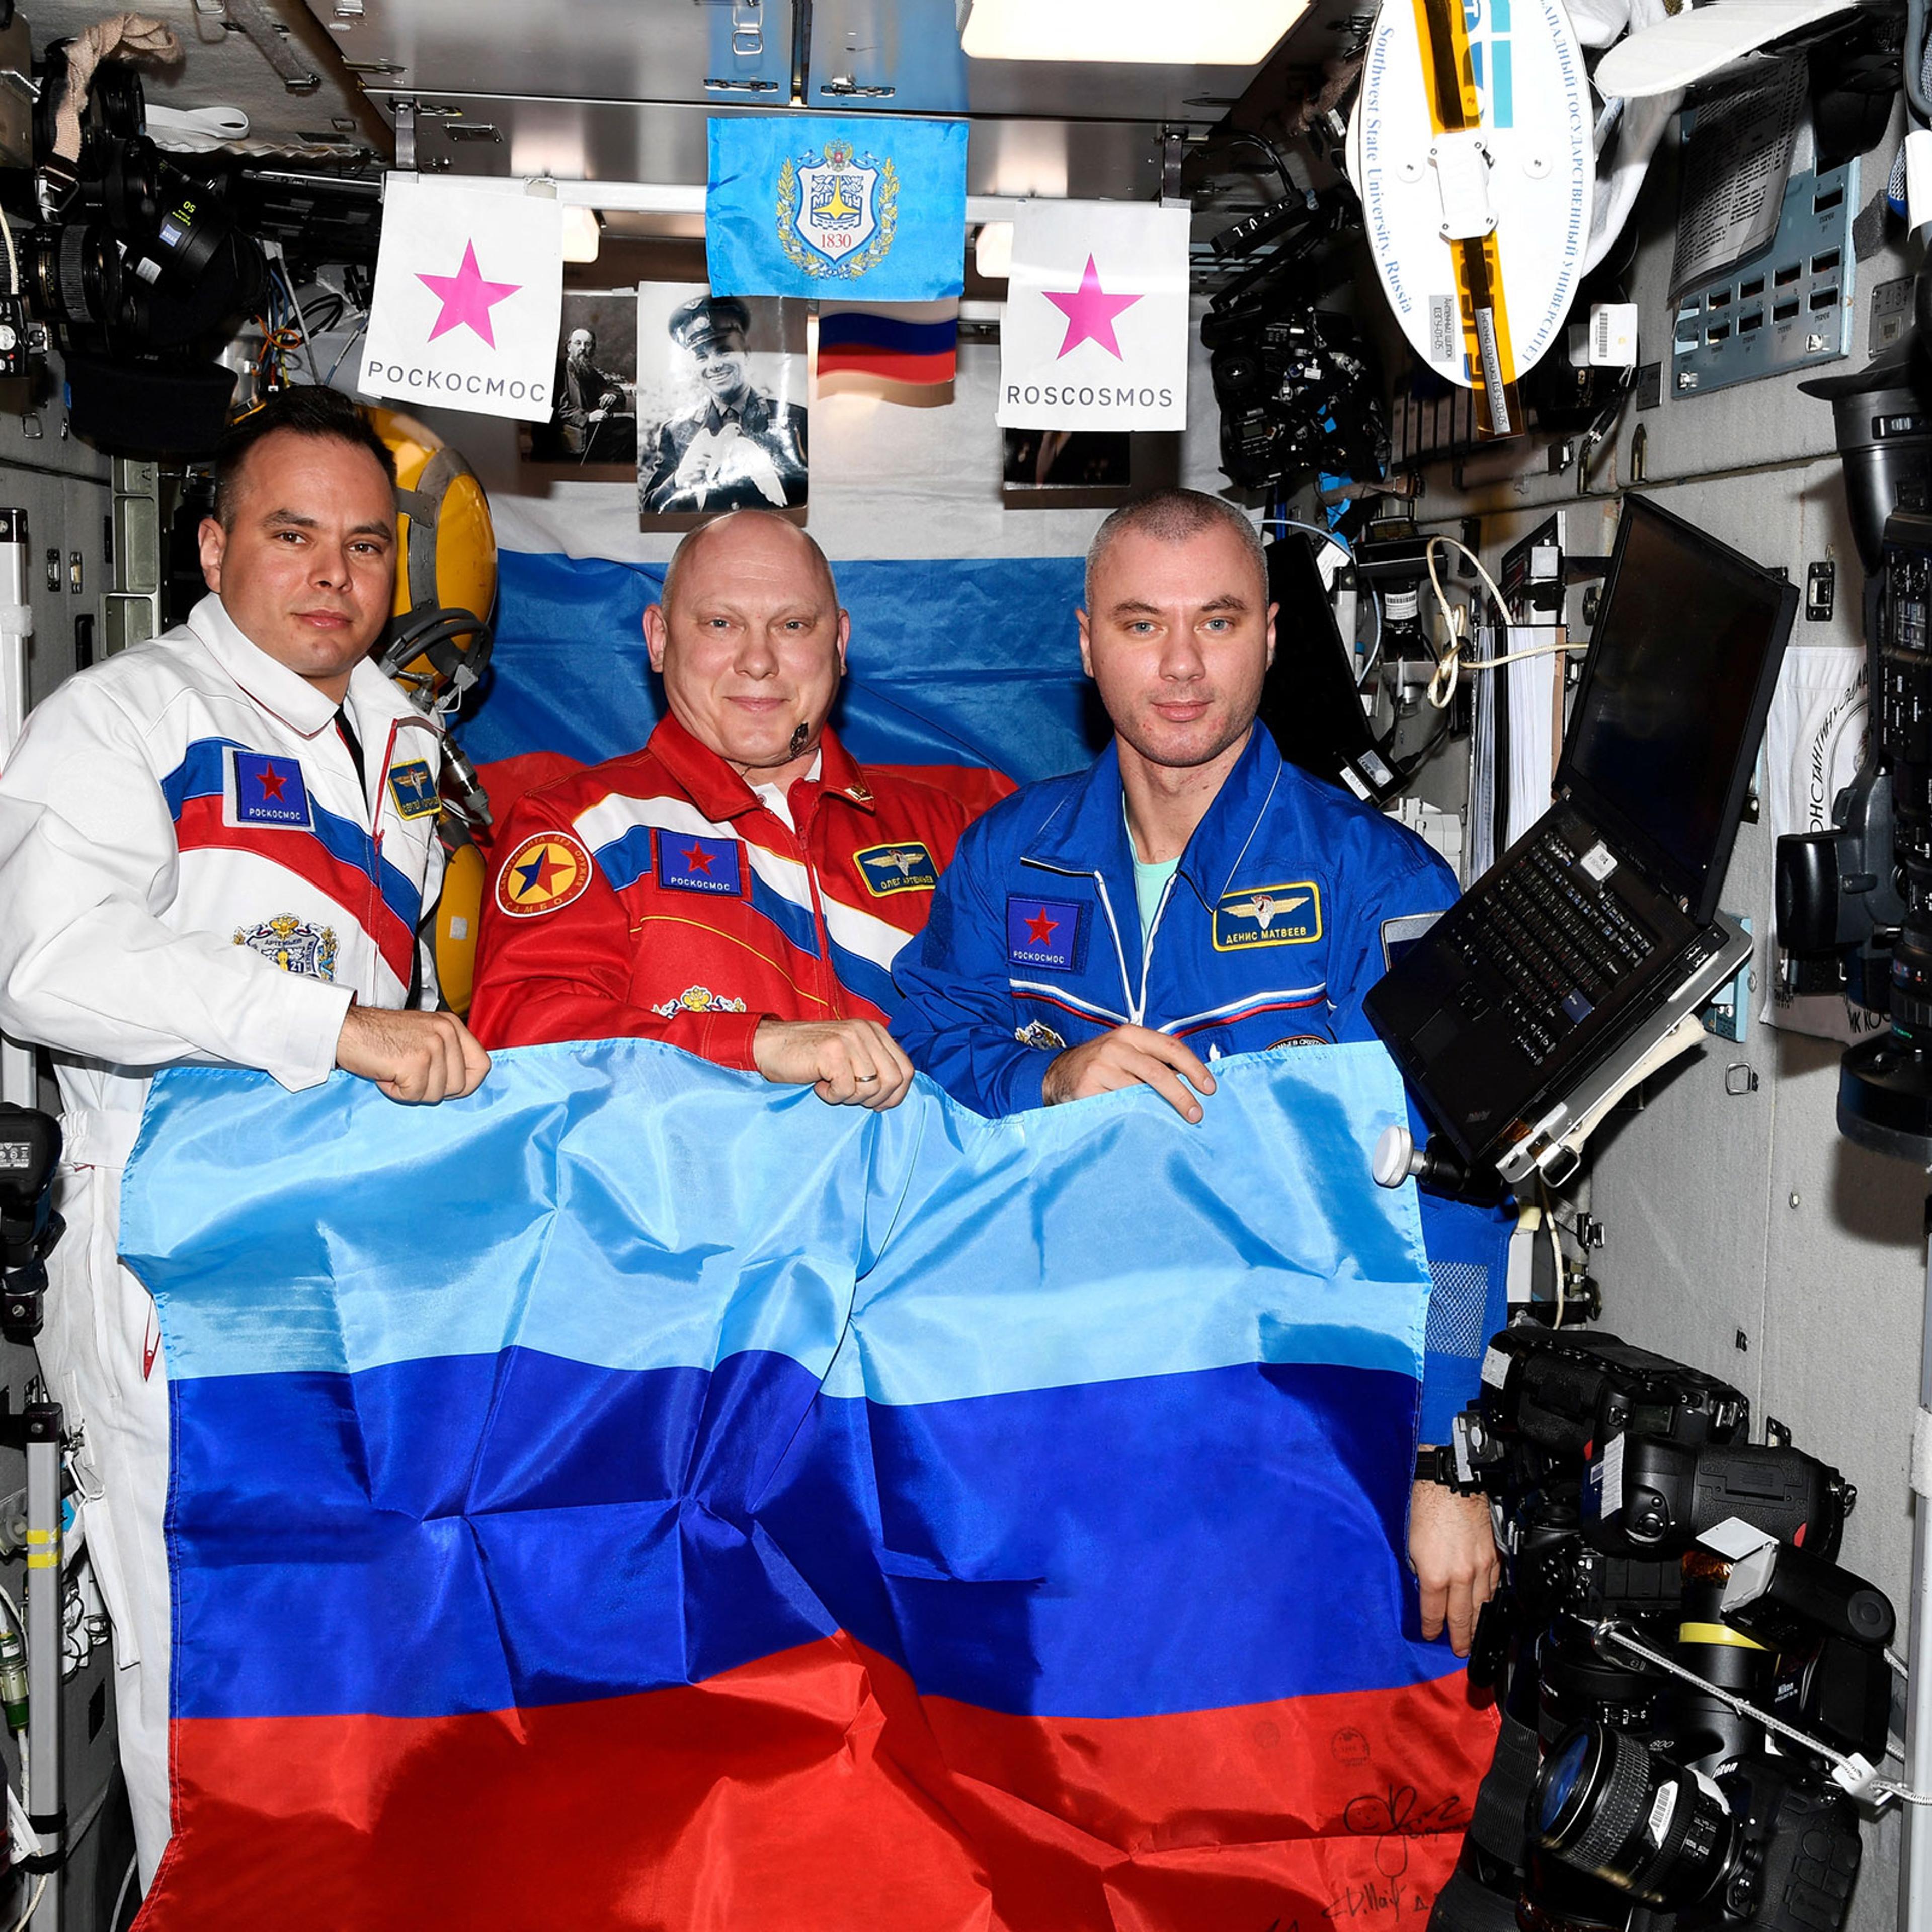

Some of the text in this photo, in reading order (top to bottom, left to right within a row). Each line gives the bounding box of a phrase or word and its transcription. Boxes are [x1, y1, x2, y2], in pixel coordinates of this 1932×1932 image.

[1367, 25, 1394, 112] Southwest
[1366, 119, 1382, 161] State
[1522, 0, 1583, 364] АПАДНЫЙ ГОСУДАРСТВЕННЫЙ УНИВЕРСИТЕТ
[822, 233, 852, 248] 1830
[1385, 260, 1412, 314] Russia
[367, 360, 546, 403] РОСКОСМОС
[1007, 385, 1172, 407] ROSCOSMOS
[249, 807, 301, 820] РОСКОСМОС
[554, 835, 572, 846] БЕЗ
[574, 850, 588, 888] ОРУЖИЯ
[670, 876, 731, 891] РОСКОСМОС
[880, 877, 900, 890] ОЛЕГ
[505, 898, 564, 913] САМБО
[1226, 926, 1307, 944] ДЕНИС МАТВЕЕВ
[1013, 951, 1065, 964] РОСКОСМОС
[290, 961, 302, 972] 21
[1650, 1740, 1674, 1749] 800
